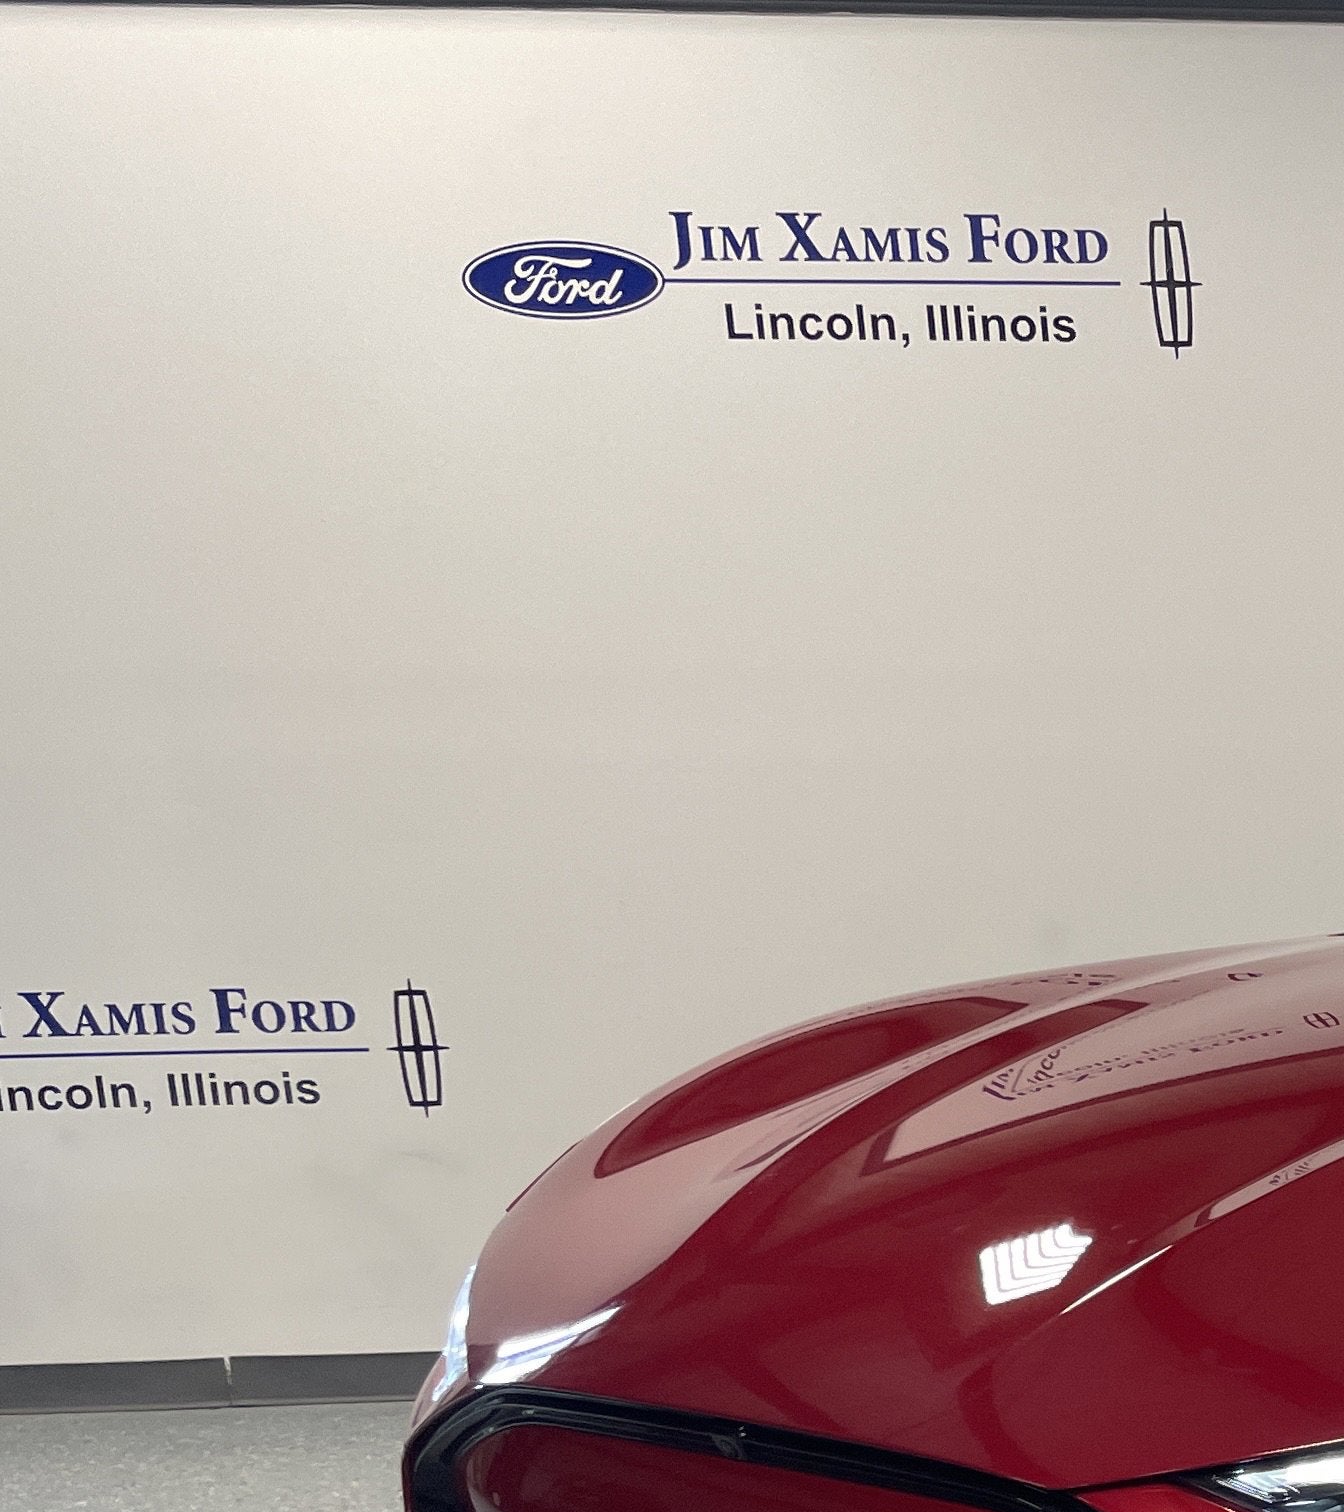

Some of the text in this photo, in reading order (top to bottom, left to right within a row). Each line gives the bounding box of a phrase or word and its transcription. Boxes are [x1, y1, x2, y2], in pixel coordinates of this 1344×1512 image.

[667, 210, 1109, 271] JIM XAMIS FORD
[502, 254, 623, 306] Ford
[724, 302, 1077, 349] Lincoln, Illinois
[16, 991, 196, 1039] XAMIS
[208, 987, 356, 1034] FORD
[0, 1070, 321, 1115] ncoln, Illinois
